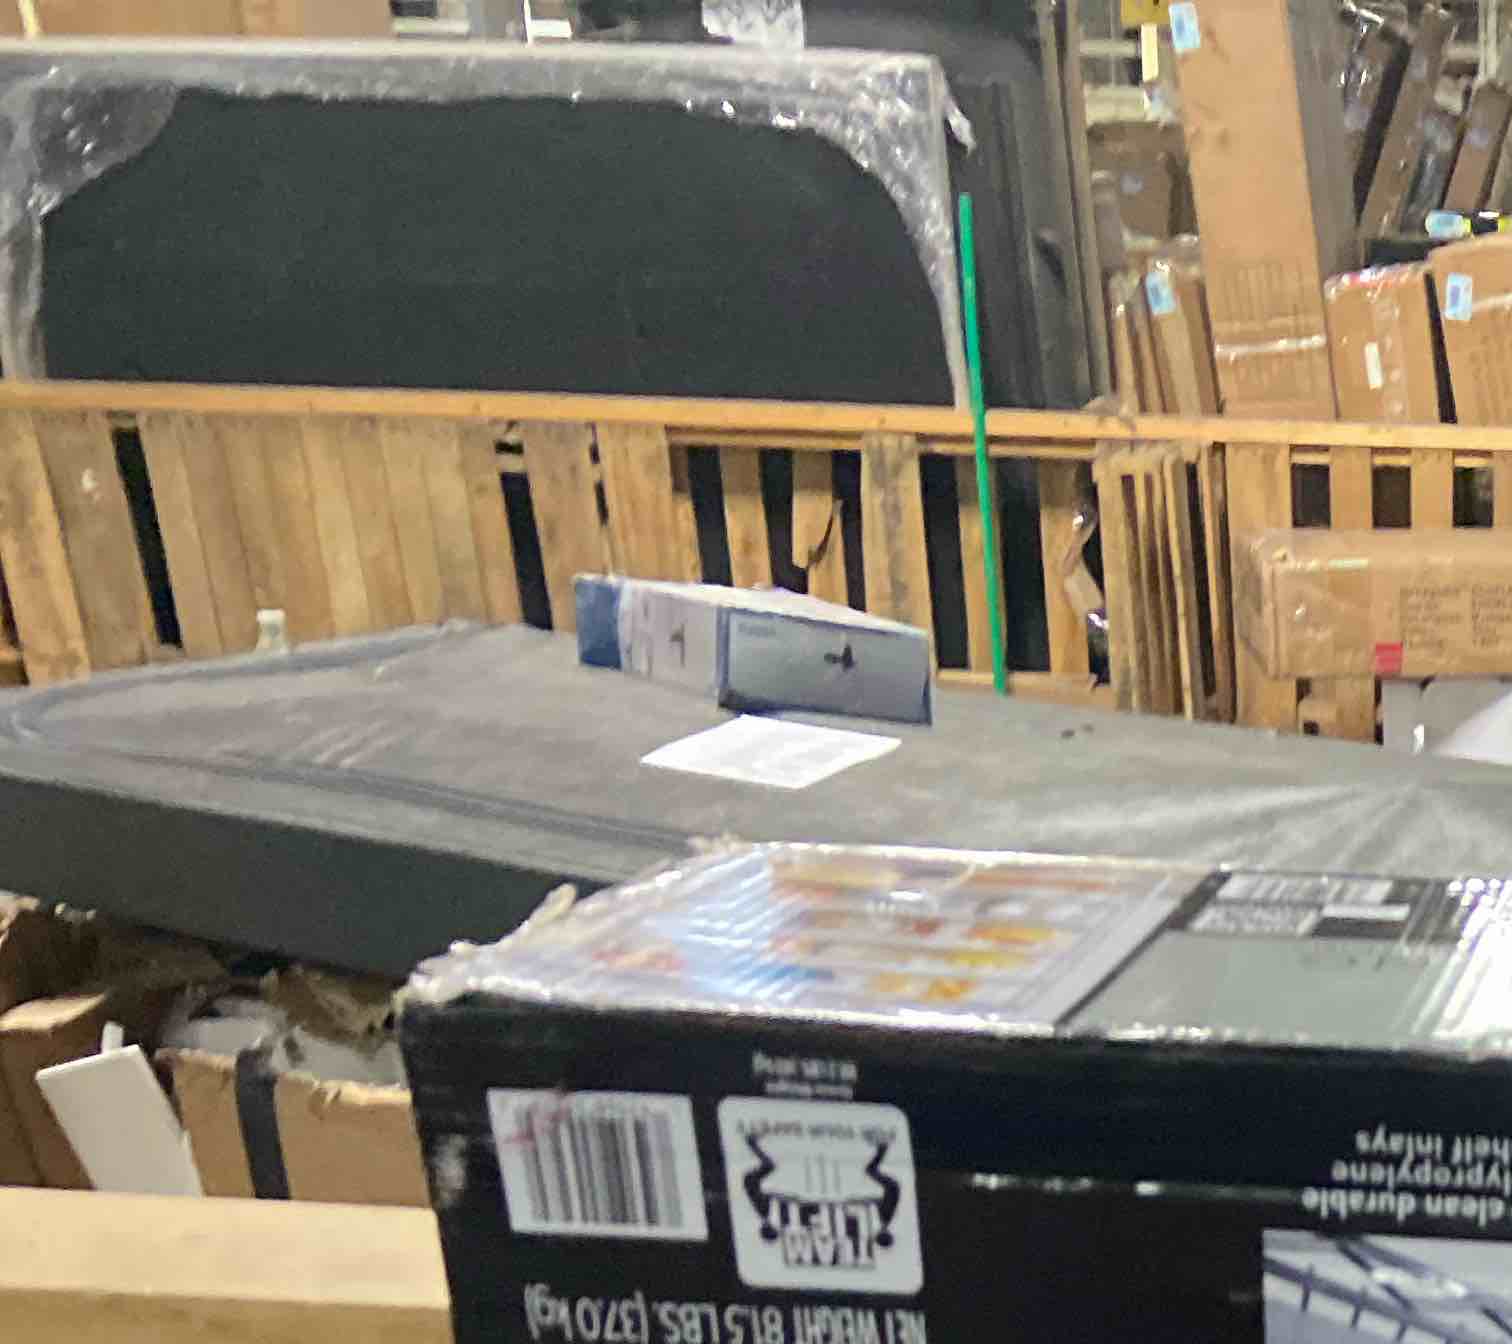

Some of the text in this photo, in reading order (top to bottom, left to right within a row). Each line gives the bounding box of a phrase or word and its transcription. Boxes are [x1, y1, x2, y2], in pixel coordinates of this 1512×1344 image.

[1355, 1123, 1444, 1163] inlays
[1301, 1186, 1417, 1221] durable
[1424, 1192, 1505, 1226] clean
